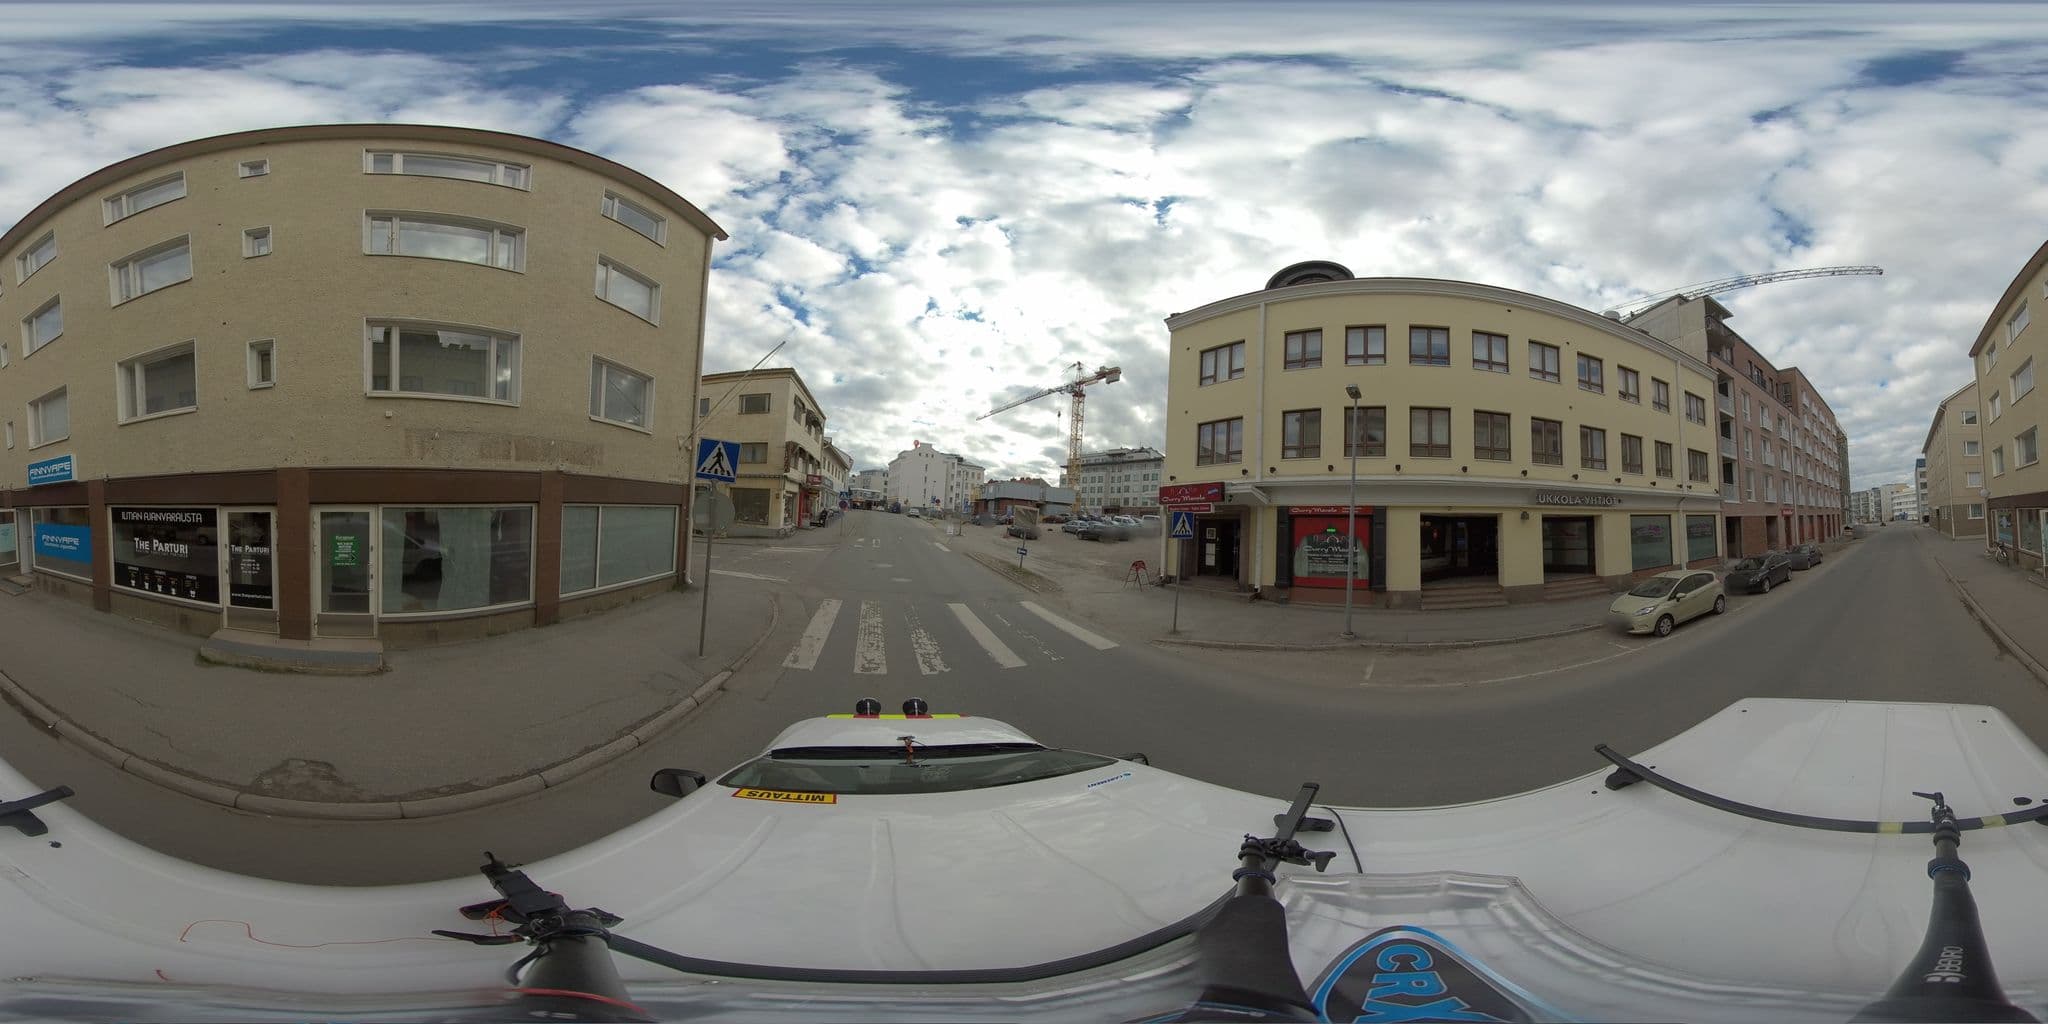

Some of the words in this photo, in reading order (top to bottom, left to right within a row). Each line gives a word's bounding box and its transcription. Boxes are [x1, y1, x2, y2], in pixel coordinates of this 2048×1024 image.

[144, 512, 202, 523] AJANVARAUSTA
[747, 790, 825, 802] MITTAUS
[1934, 945, 1963, 971] BENRO
